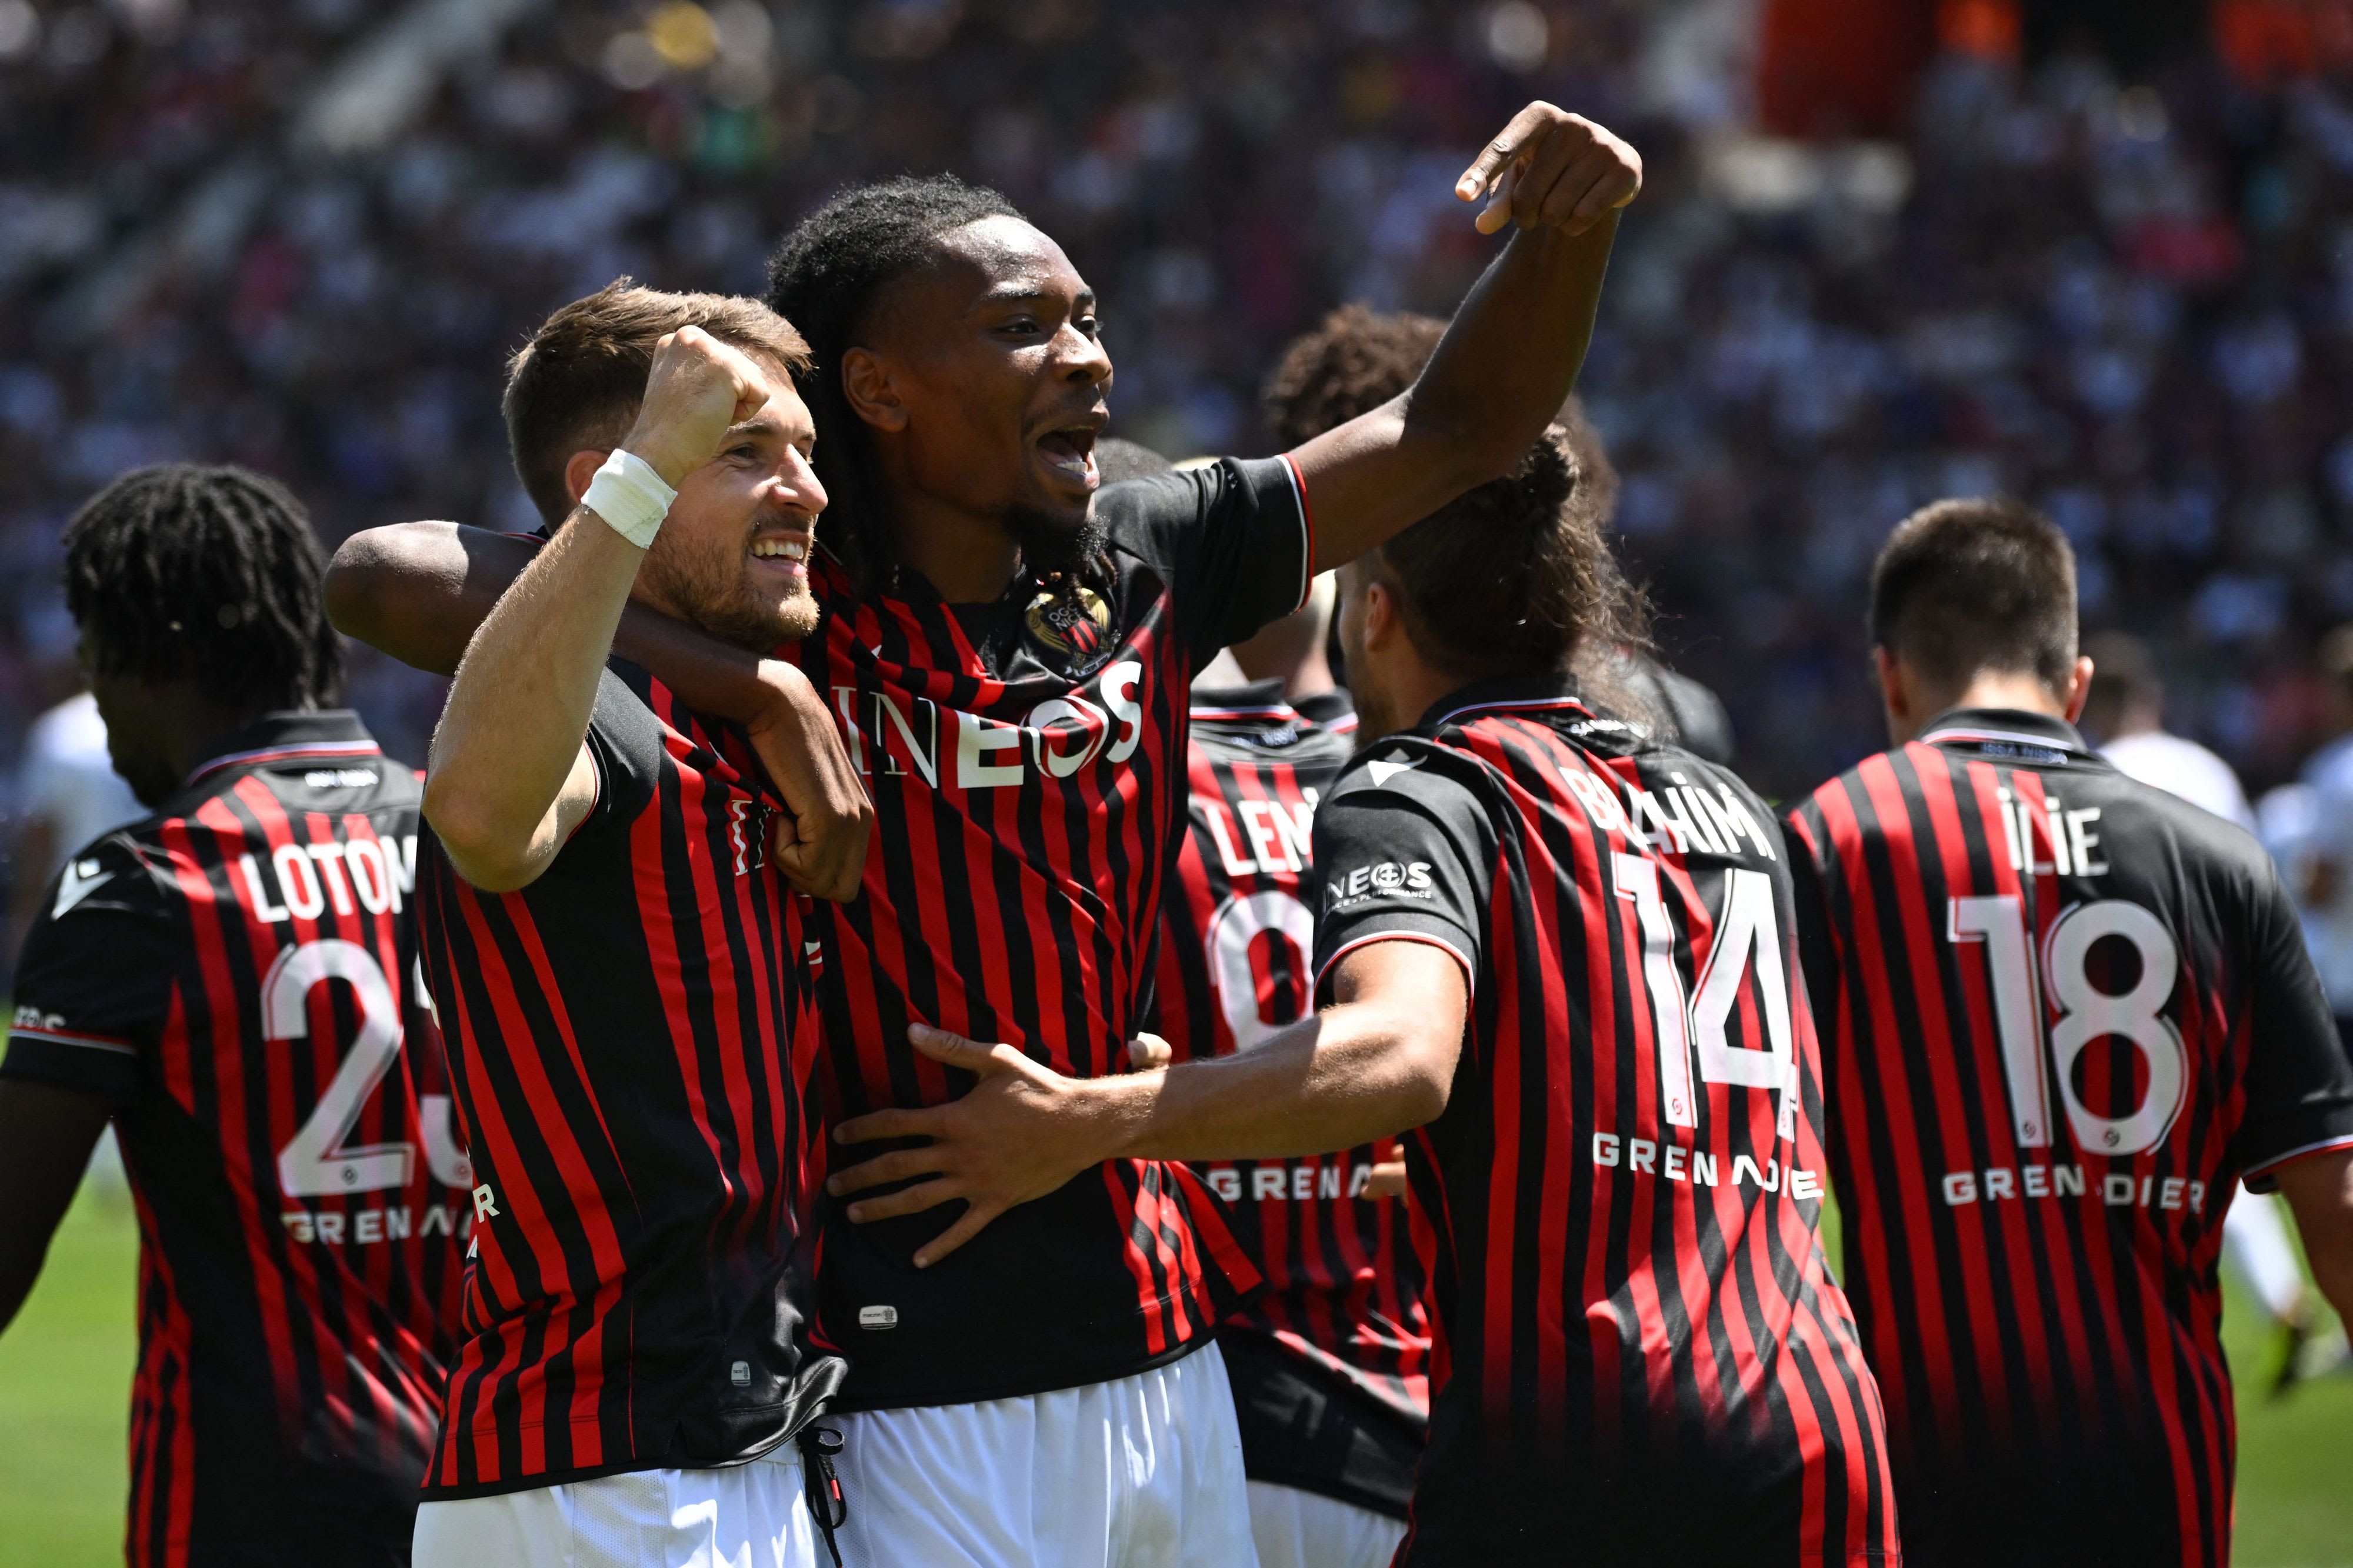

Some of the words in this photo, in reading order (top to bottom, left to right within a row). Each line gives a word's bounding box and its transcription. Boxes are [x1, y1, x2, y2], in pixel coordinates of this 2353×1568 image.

[831, 660, 1142, 790] INEOS
[1206, 787, 1320, 876] LEM
[1612, 851, 1800, 1143] 14
[1947, 895, 2189, 1155] 18
[1942, 1163, 2205, 1213] GRENDIER
